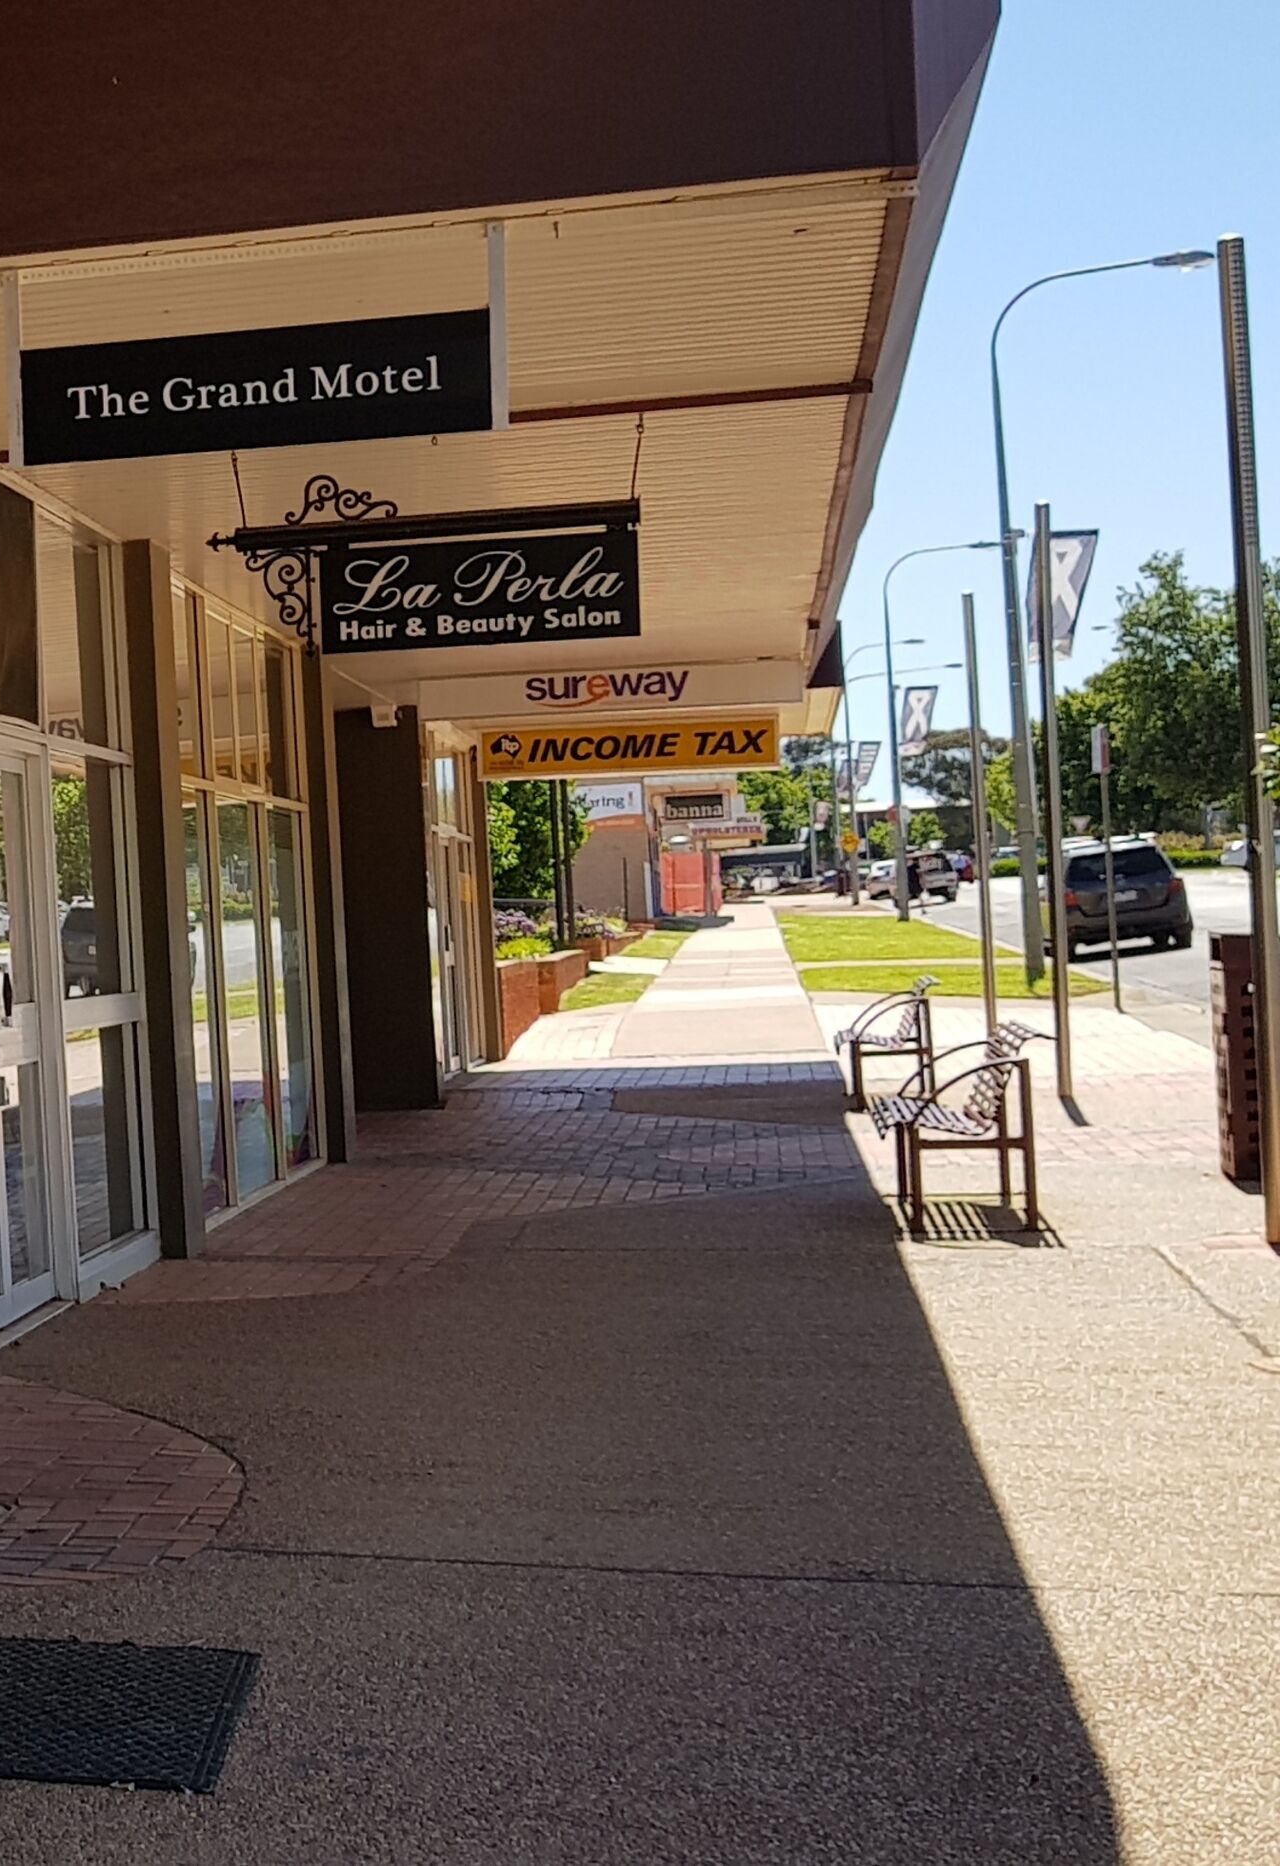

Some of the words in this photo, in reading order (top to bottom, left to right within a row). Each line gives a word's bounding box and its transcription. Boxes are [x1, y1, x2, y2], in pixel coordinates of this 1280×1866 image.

[66, 384, 149, 419] The
[162, 368, 299, 412] Grand
[309, 355, 442, 400] Motel
[332, 555, 442, 615] La
[453, 546, 625, 607] Perla
[340, 619, 398, 641] Hair
[405, 617, 427, 637] &
[436, 613, 535, 636] Beauty
[543, 605, 622, 629] Salon
[525, 670, 689, 703] sureway
[527, 732, 681, 763] INCOME
[694, 728, 769, 756] TAX
